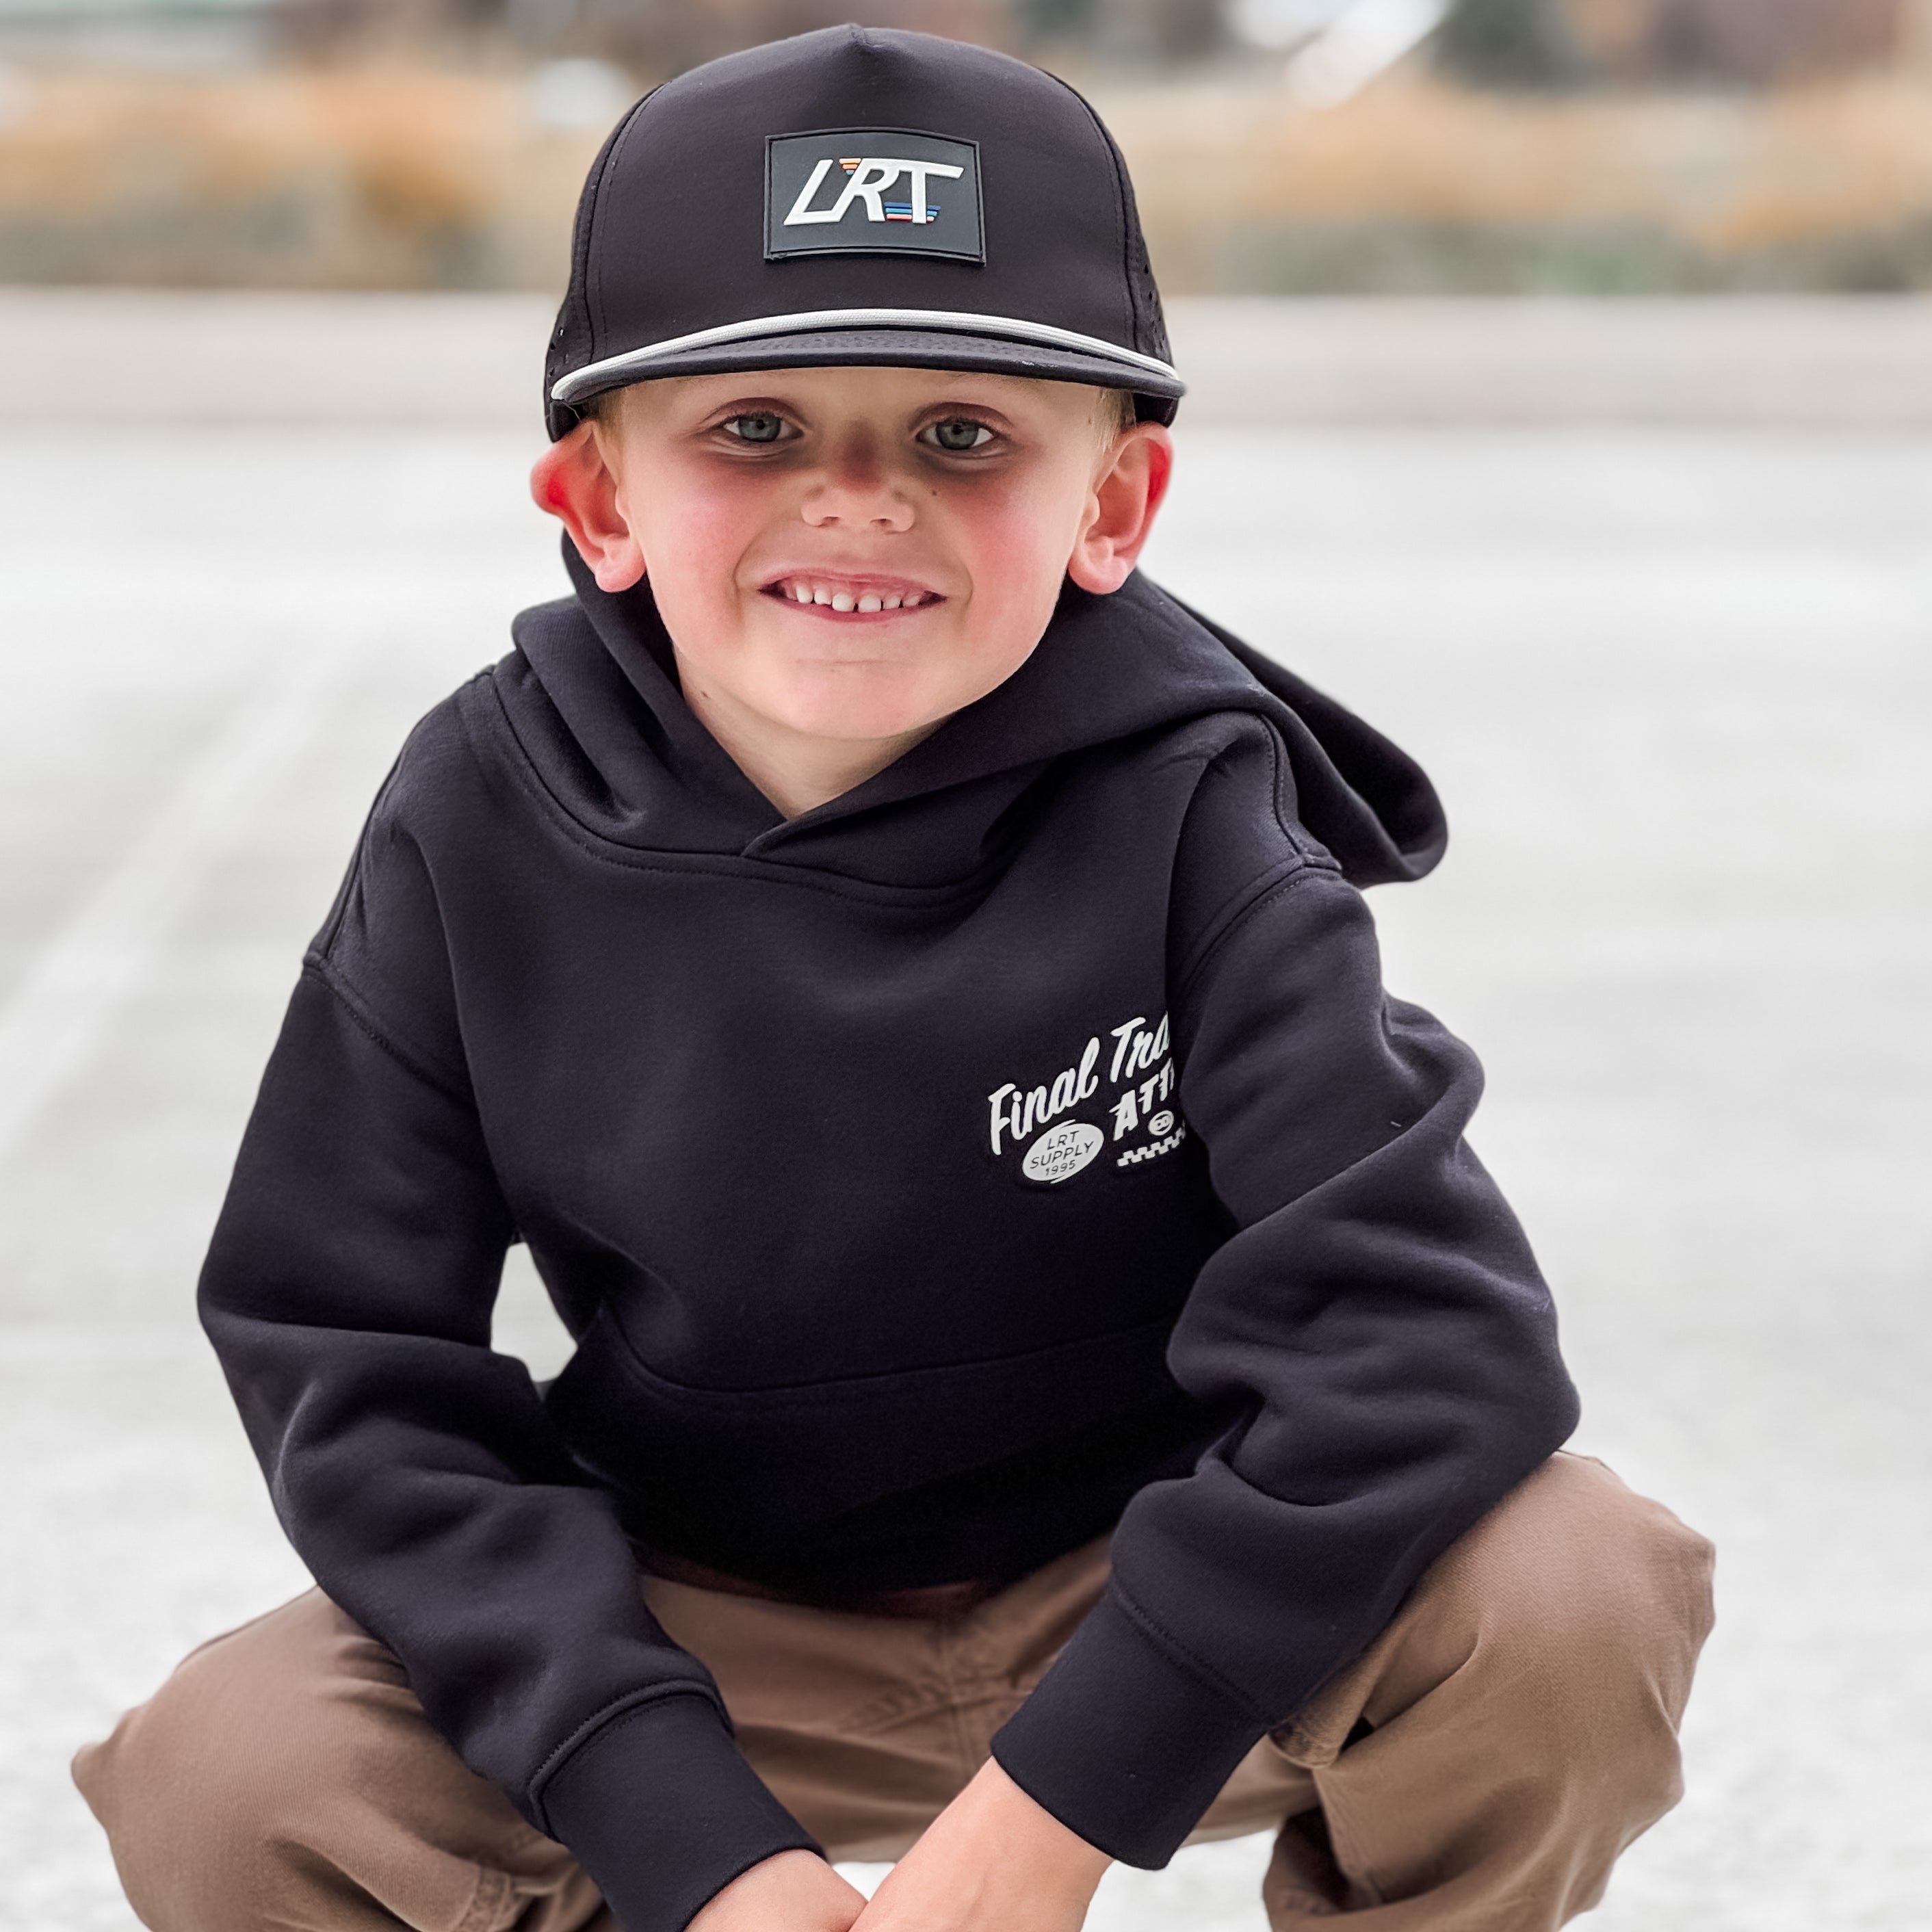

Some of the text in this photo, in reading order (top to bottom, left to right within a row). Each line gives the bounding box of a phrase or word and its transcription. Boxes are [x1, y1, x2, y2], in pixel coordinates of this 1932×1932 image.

[783, 157, 964, 225] LRT
[988, 1037, 1100, 1156] Final
[1047, 1130, 1080, 1150] LRT
[1030, 1141, 1094, 1169] SUPPLY
[1045, 1160, 1075, 1176] 1995
